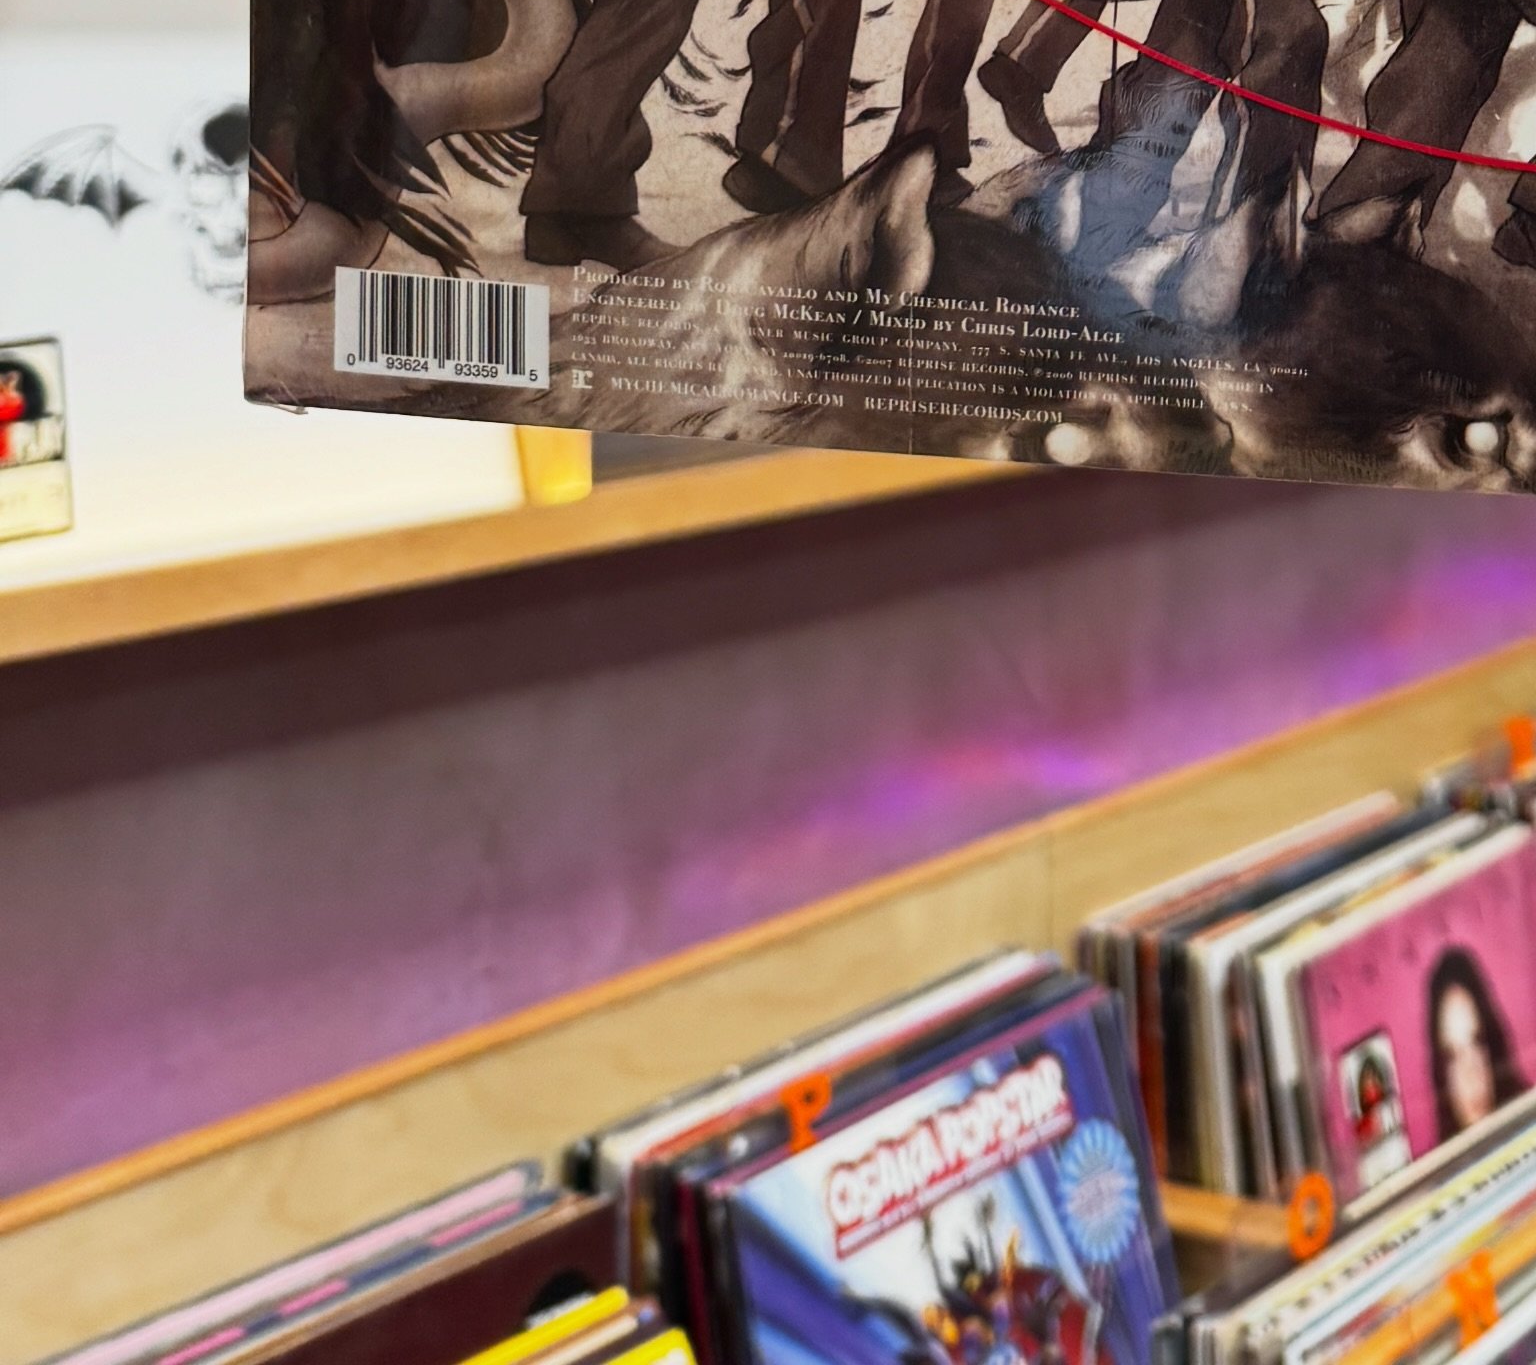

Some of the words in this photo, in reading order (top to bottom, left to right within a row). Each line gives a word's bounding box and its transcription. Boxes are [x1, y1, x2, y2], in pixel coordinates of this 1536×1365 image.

[572, 266, 665, 288] PRODUCED
[672, 279, 693, 290] BY
[824, 290, 859, 303] AND
[866, 288, 893, 306] MY
[900, 290, 989, 312] CHEMICAL
[996, 296, 1080, 319] ROMANCE
[572, 287, 681, 311] ENGINEERED
[852, 309, 863, 325] /
[869, 309, 927, 330] MIXED
[933, 319, 955, 331] BY
[961, 316, 1015, 336] CHRIS
[1022, 320, 1126, 344] LORD-ALGE
[571, 312, 630, 327] REPRISE
[792, 330, 834, 342] MUSIC
[842, 334, 888, 347] GROUP
[970, 346, 990, 357] 777
[1000, 347, 1011, 356] S.
[1019, 347, 1061, 360] SANTA
[1070, 350, 1086, 361] FE
[1136, 355, 1161, 367] LOS
[1244, 361, 1261, 373] CA
[346, 353, 356, 366] 0
[386, 356, 429, 373] 93624
[454, 363, 499, 378] 93359
[529, 369, 539, 382] 5
[627, 356, 650, 367] ALL
[655, 358, 703, 371] RIGHTS
[788, 368, 892, 386] UNAUTHORIZED
[897, 377, 987, 393] DUPLICATION
[992, 383, 1005, 394] IS
[1011, 385, 1019, 396] A
[1025, 386, 1096, 401] VIOLATION
[899, 358, 957, 371] REPRISE
[1079, 371, 1137, 384] REPRISE
[1260, 383, 1274, 394] IN
[864, 396, 1063, 424] REPRISERECORDS.COM
